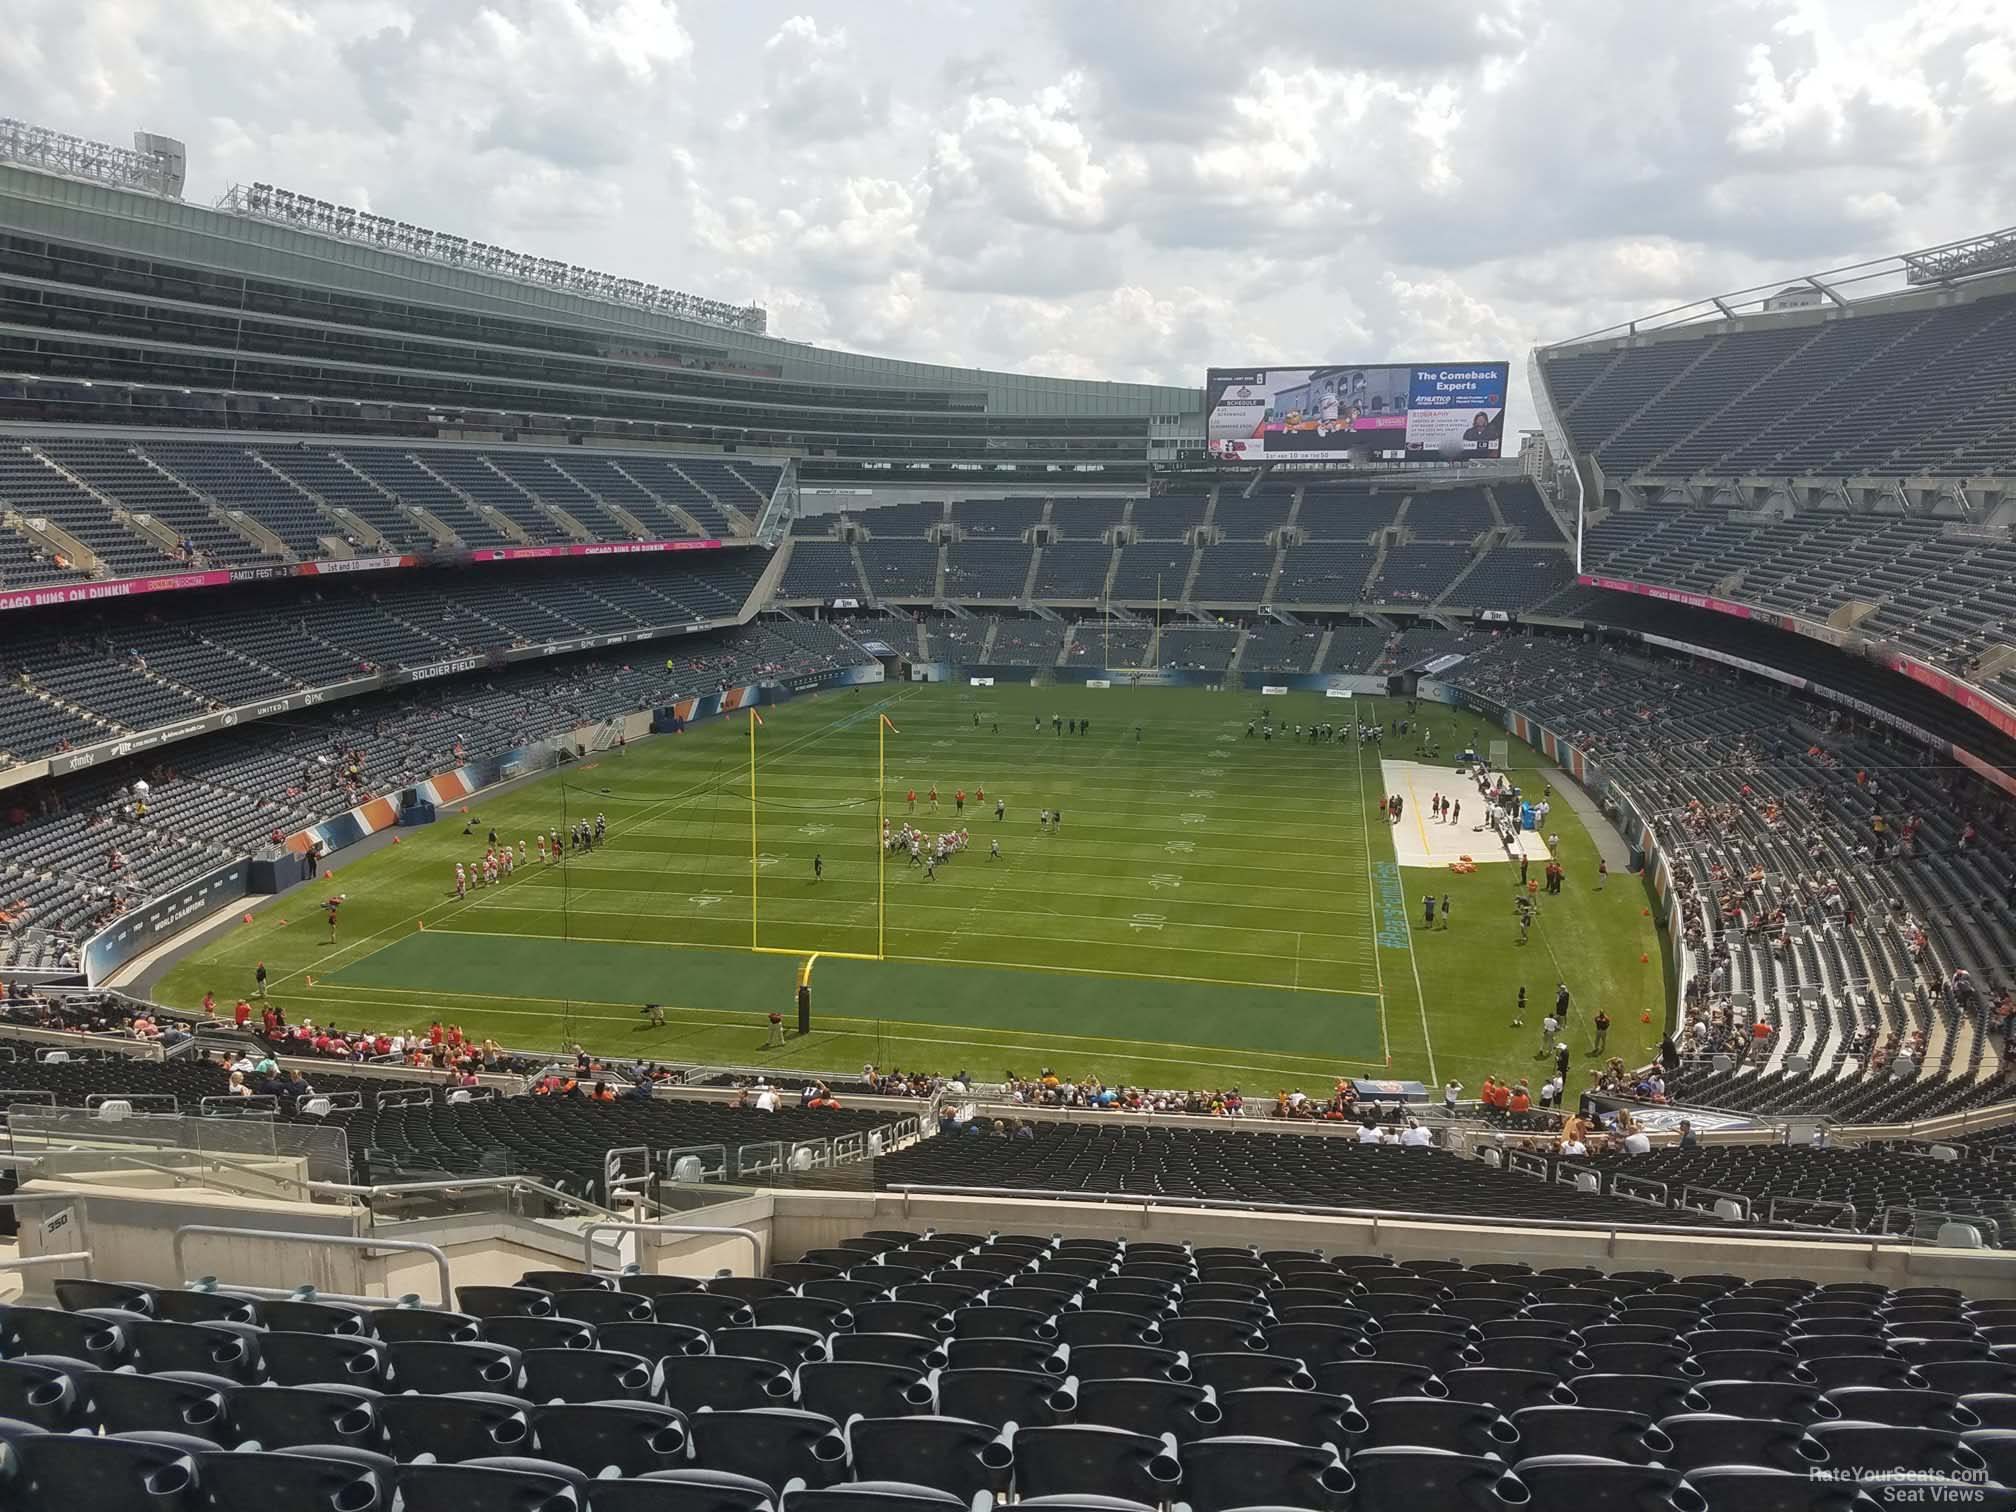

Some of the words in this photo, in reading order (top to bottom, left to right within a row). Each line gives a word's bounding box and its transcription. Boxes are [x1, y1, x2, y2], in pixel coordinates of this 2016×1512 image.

[1417, 372, 1437, 380] The
[1440, 371, 1497, 380] Comeback
[1436, 382, 1477, 391] Experts
[327, 563, 338, 572] 1st
[339, 562, 350, 571] and
[351, 561, 360, 570] 10
[230, 570, 254, 581] FAMILY
[256, 568, 273, 578] FEST
[35, 591, 65, 605] RUNS
[69, 589, 86, 601] ON
[412, 665, 450, 681] SOLDIER
[452, 660, 476, 673] FIELD
[311, 692, 324, 703] PNC
[257, 702, 282, 715] UNITED
[69, 752, 95, 769] xfinity
[803, 1086, 818, 1096] 17
[47, 1213, 69, 1234] 350
